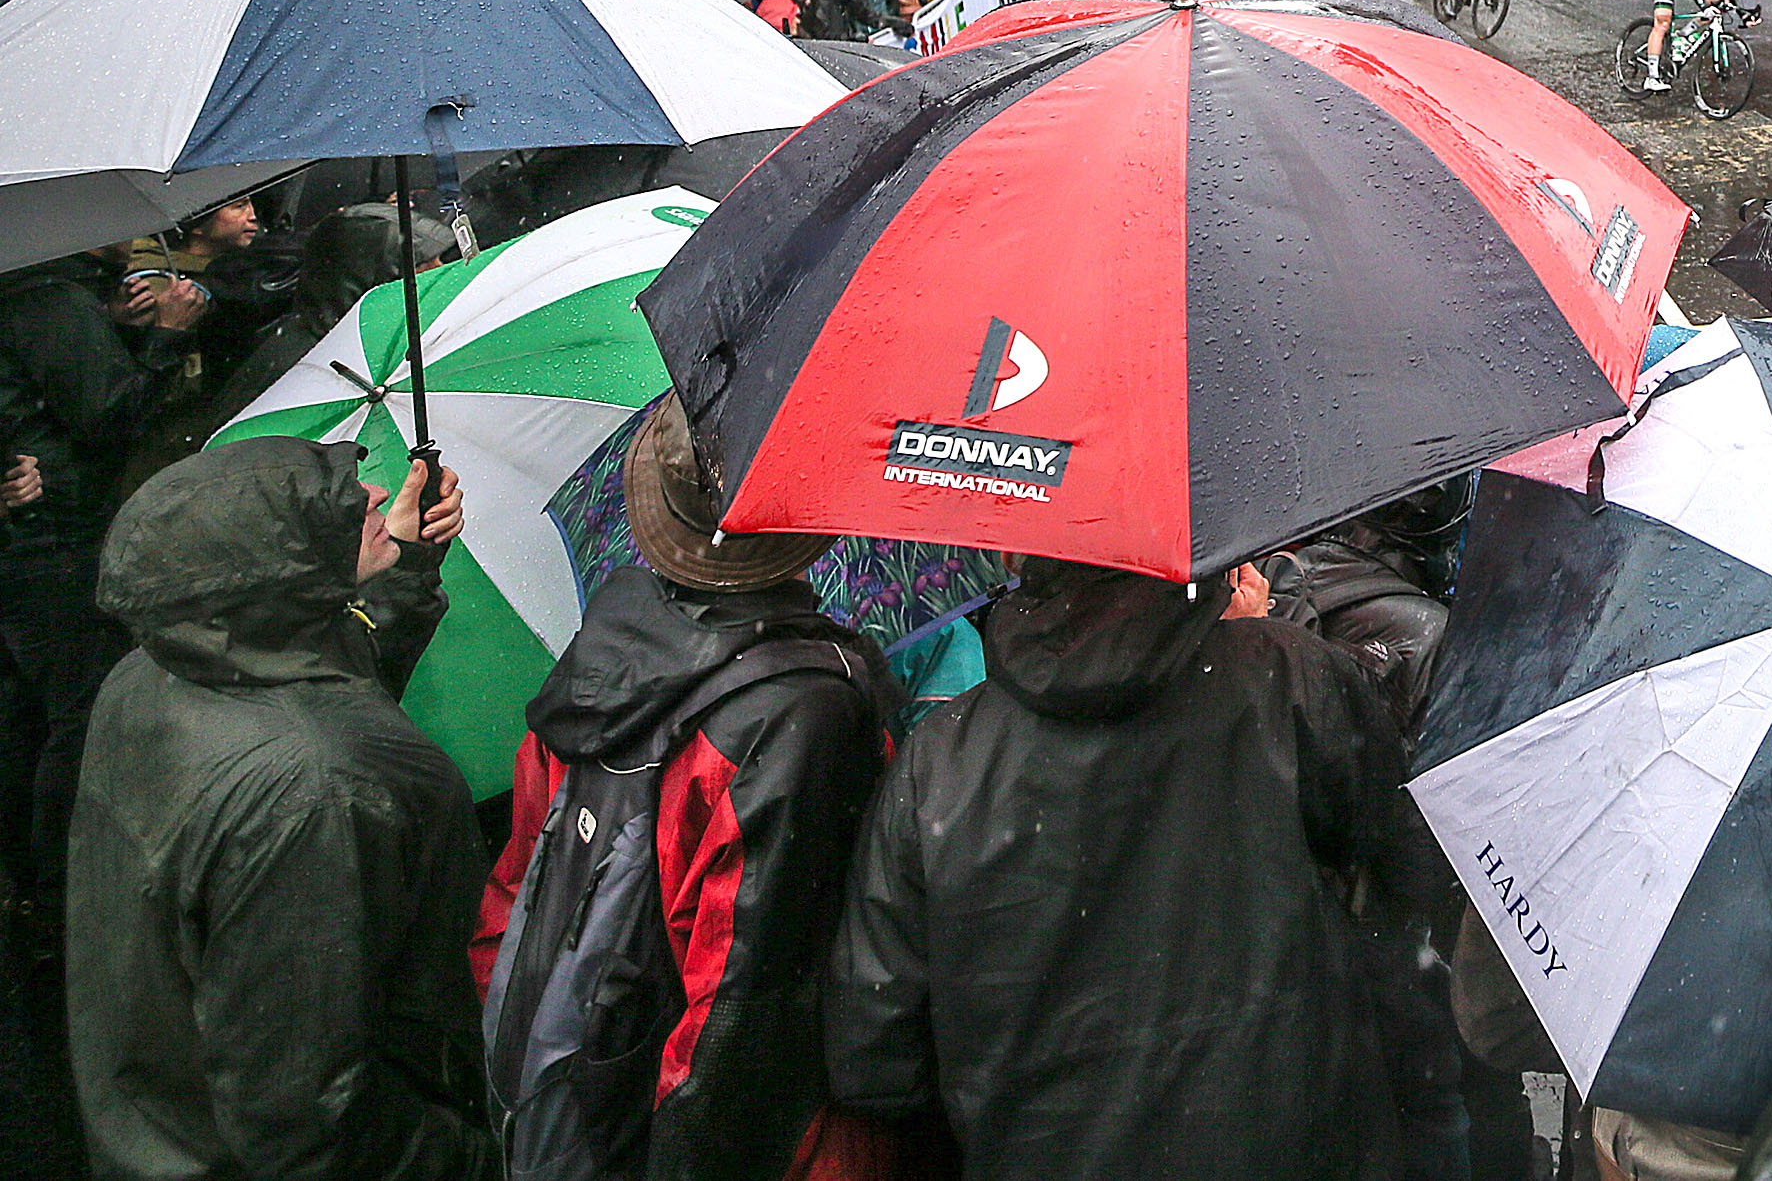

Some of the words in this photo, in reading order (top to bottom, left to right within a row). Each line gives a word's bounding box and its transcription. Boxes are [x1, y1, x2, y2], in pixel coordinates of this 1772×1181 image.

[1595, 210, 1634, 288] DONNAY
[882, 465, 1052, 503] INTERNATIONAL
[1475, 839, 1569, 980] HARDY
